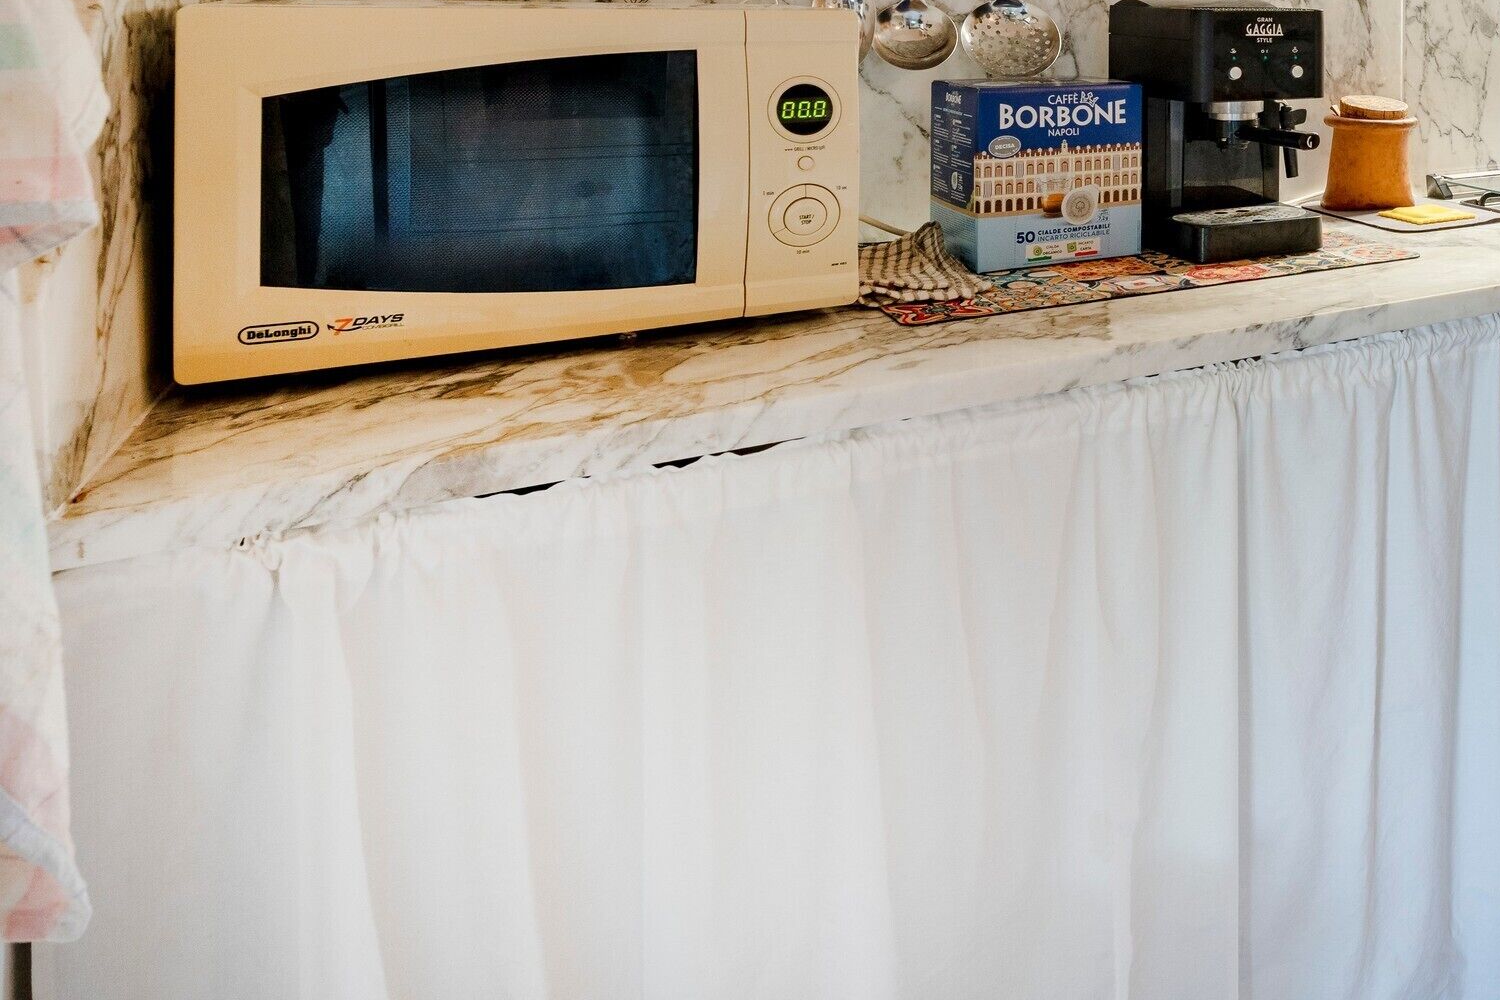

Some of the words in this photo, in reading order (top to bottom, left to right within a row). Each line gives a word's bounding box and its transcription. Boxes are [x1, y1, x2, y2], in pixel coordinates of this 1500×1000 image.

[1245, 23, 1283, 36] GAGGIA
[1047, 92, 1079, 105] CAFFÈ
[999, 98, 1127, 130] BORBONE
[1047, 127, 1080, 137] NAPOLI
[1016, 231, 1036, 244] 50
[1037, 228, 1061, 236] CIALDE
[1037, 233, 1068, 242] INCARTO
[1069, 229, 1110, 239] RICICLABILE
[334, 316, 353, 336] 7
[352, 313, 405, 327] DAYS
[246, 325, 312, 340] DeLonghi
